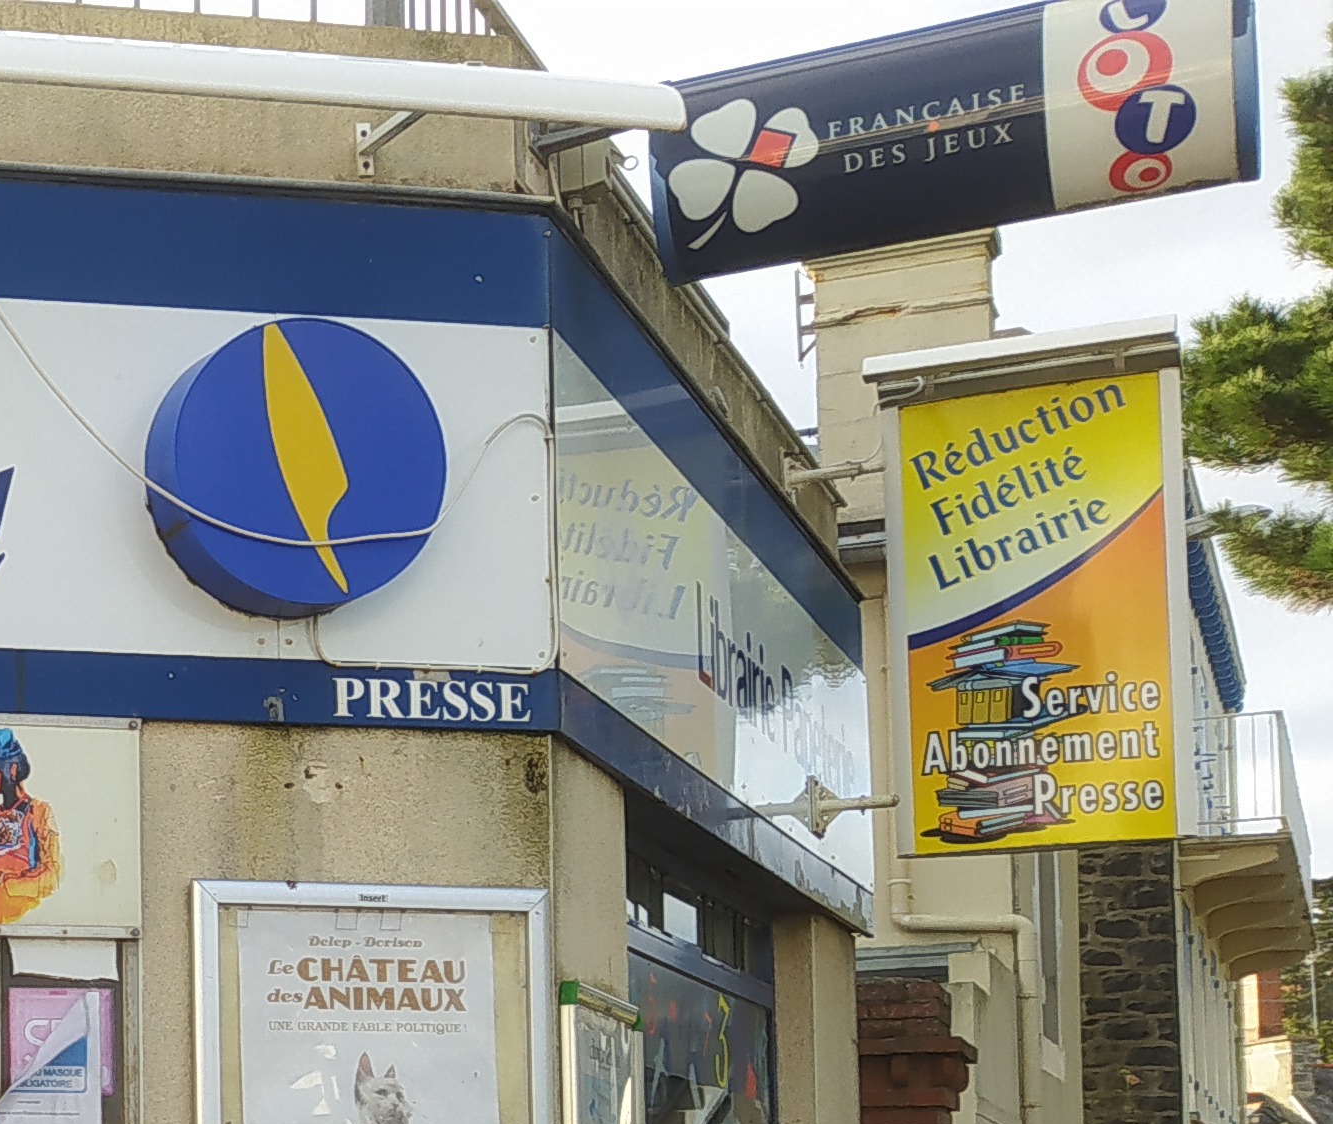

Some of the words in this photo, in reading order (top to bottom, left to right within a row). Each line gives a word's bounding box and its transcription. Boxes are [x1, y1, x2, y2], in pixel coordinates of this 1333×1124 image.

[1077, 0, 1197, 192] LOTO
[843, 144, 906, 174] DES
[924, 122, 1014, 162] JEUX
[909, 383, 1127, 491] Réduction
[930, 446, 1087, 536] Fidélité
[928, 497, 1111, 590] Librairie
[696, 580, 776, 743] Librairie
[332, 676, 532, 723] PRESSE
[1021, 671, 1161, 718] Service
[922, 721, 1160, 776] Abonnement
[1033, 772, 1163, 816] Presse
[309, 936, 352, 948] Delep
[364, 937, 423, 948] Dorison
[297, 954, 467, 984] CHÂTEAU
[267, 988, 303, 1003] des
[303, 986, 467, 1012] ANIMAUX
[268, 1021, 294, 1031] UNE
[297, 1022, 348, 1032] GRANDE
[352, 1022, 392, 1032] FABLE
[396, 1023, 461, 1035] POLITIQUE
[46, 1069, 82, 1077] MASQUE
